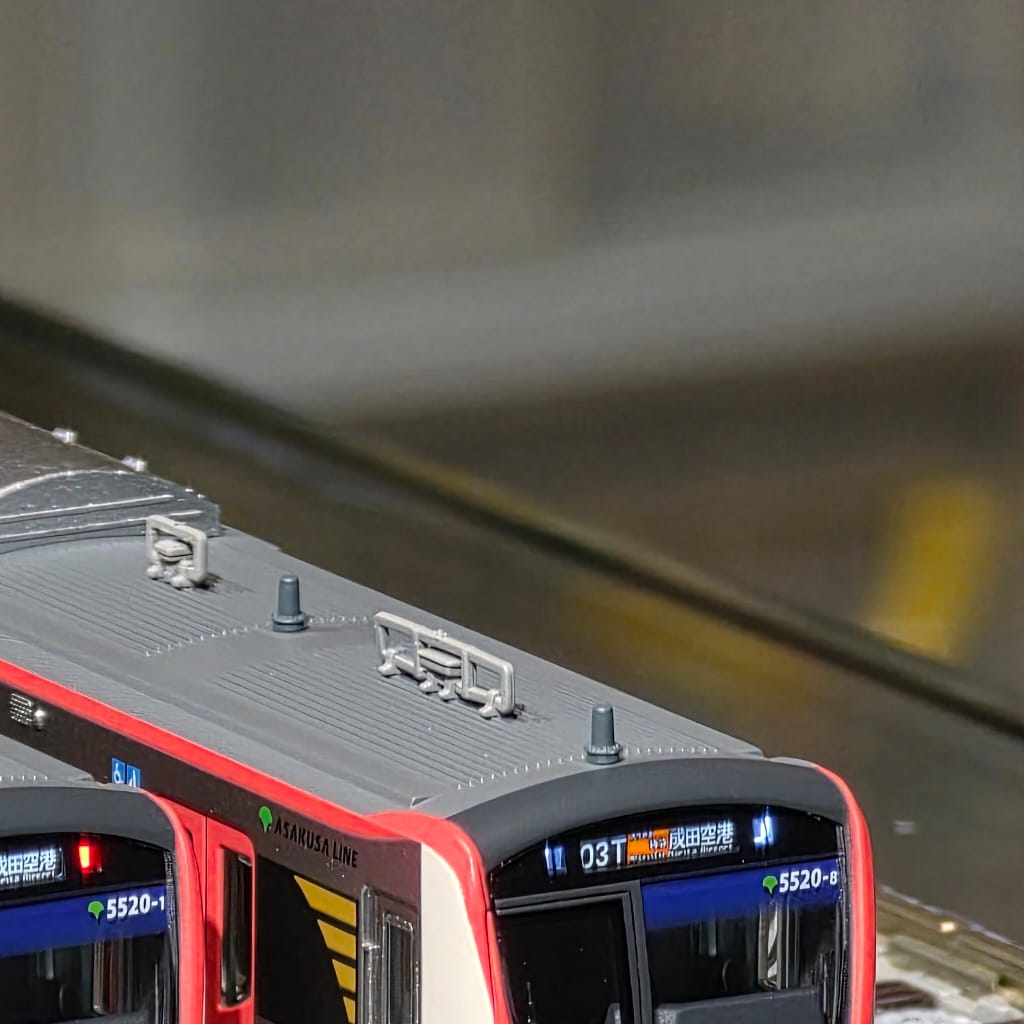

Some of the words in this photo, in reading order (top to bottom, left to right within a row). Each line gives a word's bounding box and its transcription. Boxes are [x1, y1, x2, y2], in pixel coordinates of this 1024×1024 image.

[274, 816, 329, 857] ASAKUSA
[332, 841, 358, 868] LINE
[580, 838, 626, 869] 03T
[669, 819, 734, 850] 成田空港
[779, 868, 837, 893] 5520-8
[107, 894, 165, 919] 5520-1
